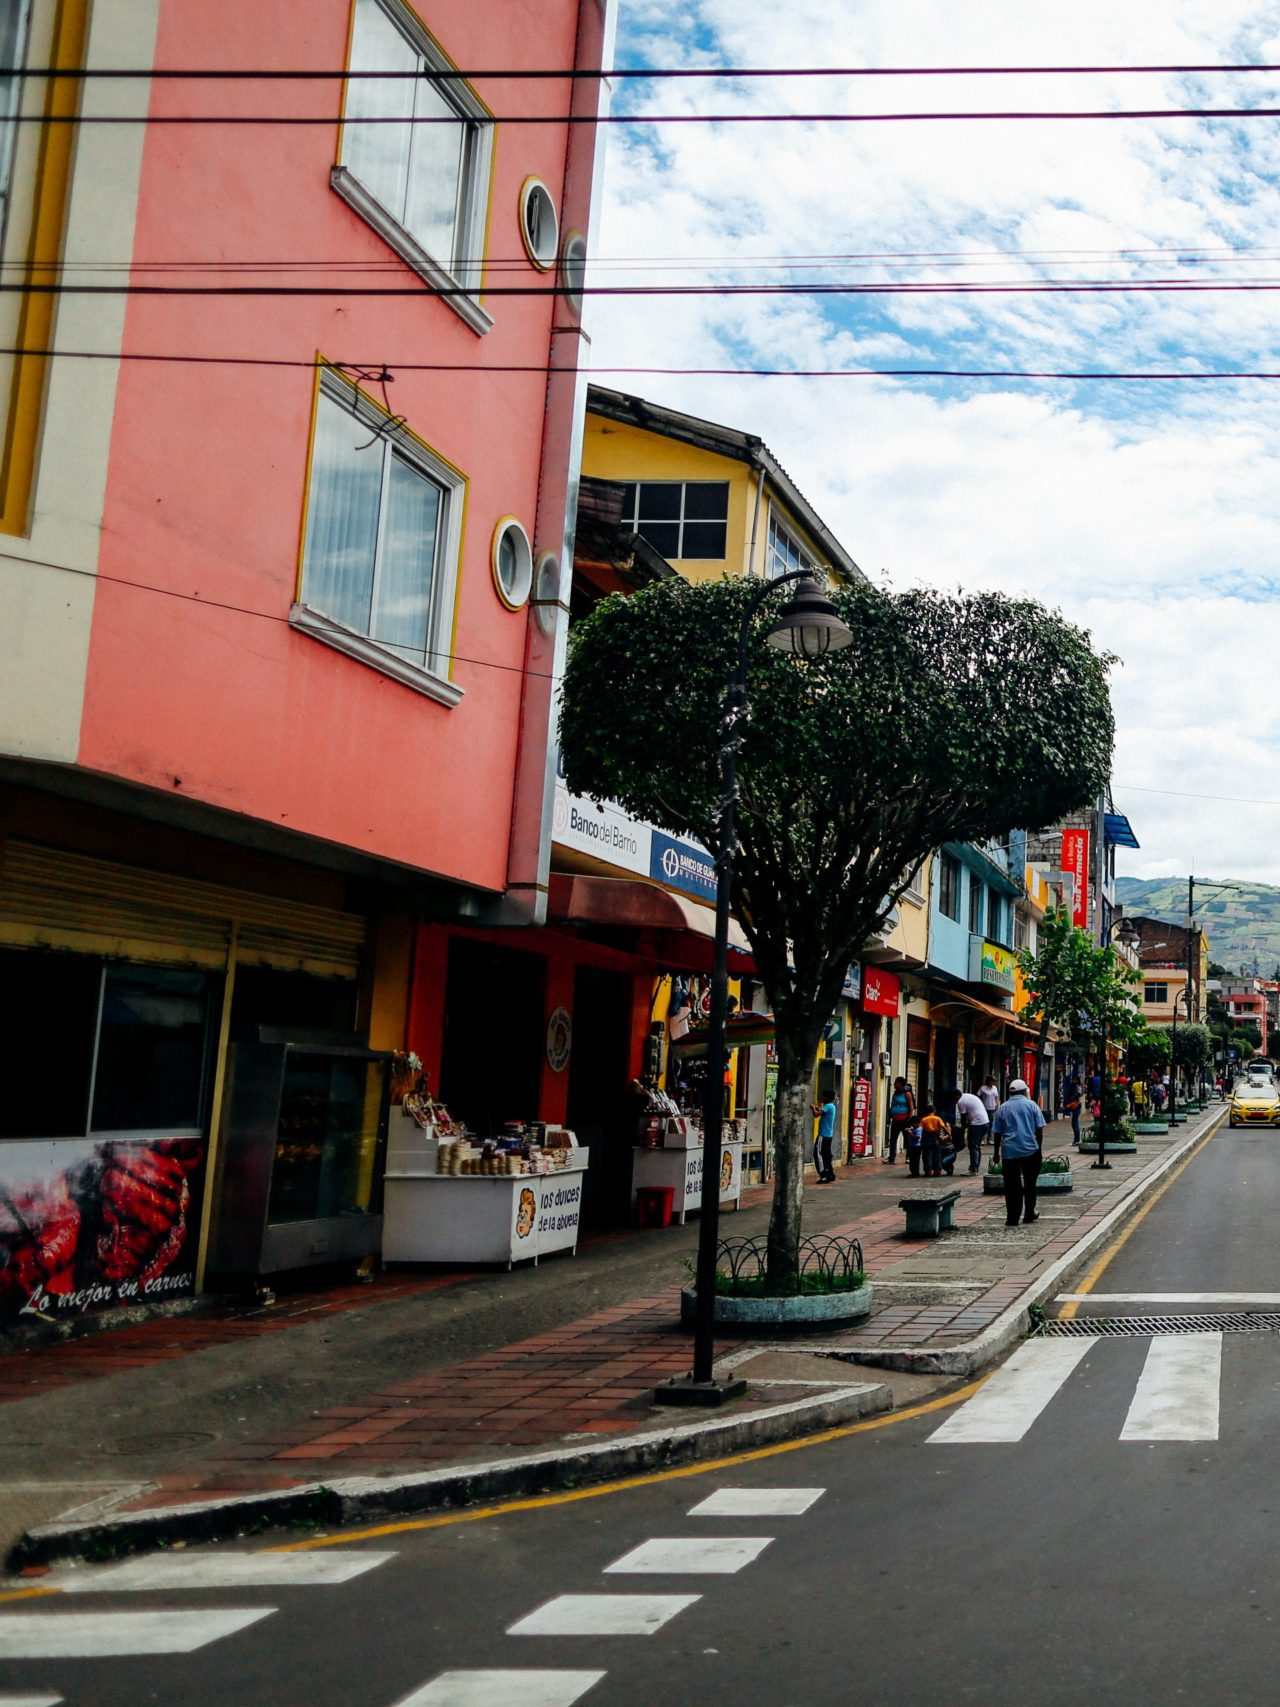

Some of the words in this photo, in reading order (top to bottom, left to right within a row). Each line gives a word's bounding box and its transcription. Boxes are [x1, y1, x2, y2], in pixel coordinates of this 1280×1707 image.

[570, 807, 599, 838] Banco
[600, 823, 613, 844] del
[613, 826, 637, 854] Barrio
[680, 854, 697, 871] BANCO
[697, 862, 703, 874] DE
[866, 982, 880, 1002] Claro
[852, 1085, 868, 1144] CABINAS
[541, 1192, 554, 1209] los
[555, 1186, 580, 1206] dulces
[538, 1216, 548, 1232] de
[548, 1216, 555, 1230] la
[556, 1212, 578, 1231] abuela
[18, 1284, 50, 1315] Lo
[58, 1282, 112, 1312] mejor
[118, 1280, 139, 1298] en
[144, 1271, 192, 1294] carnes
